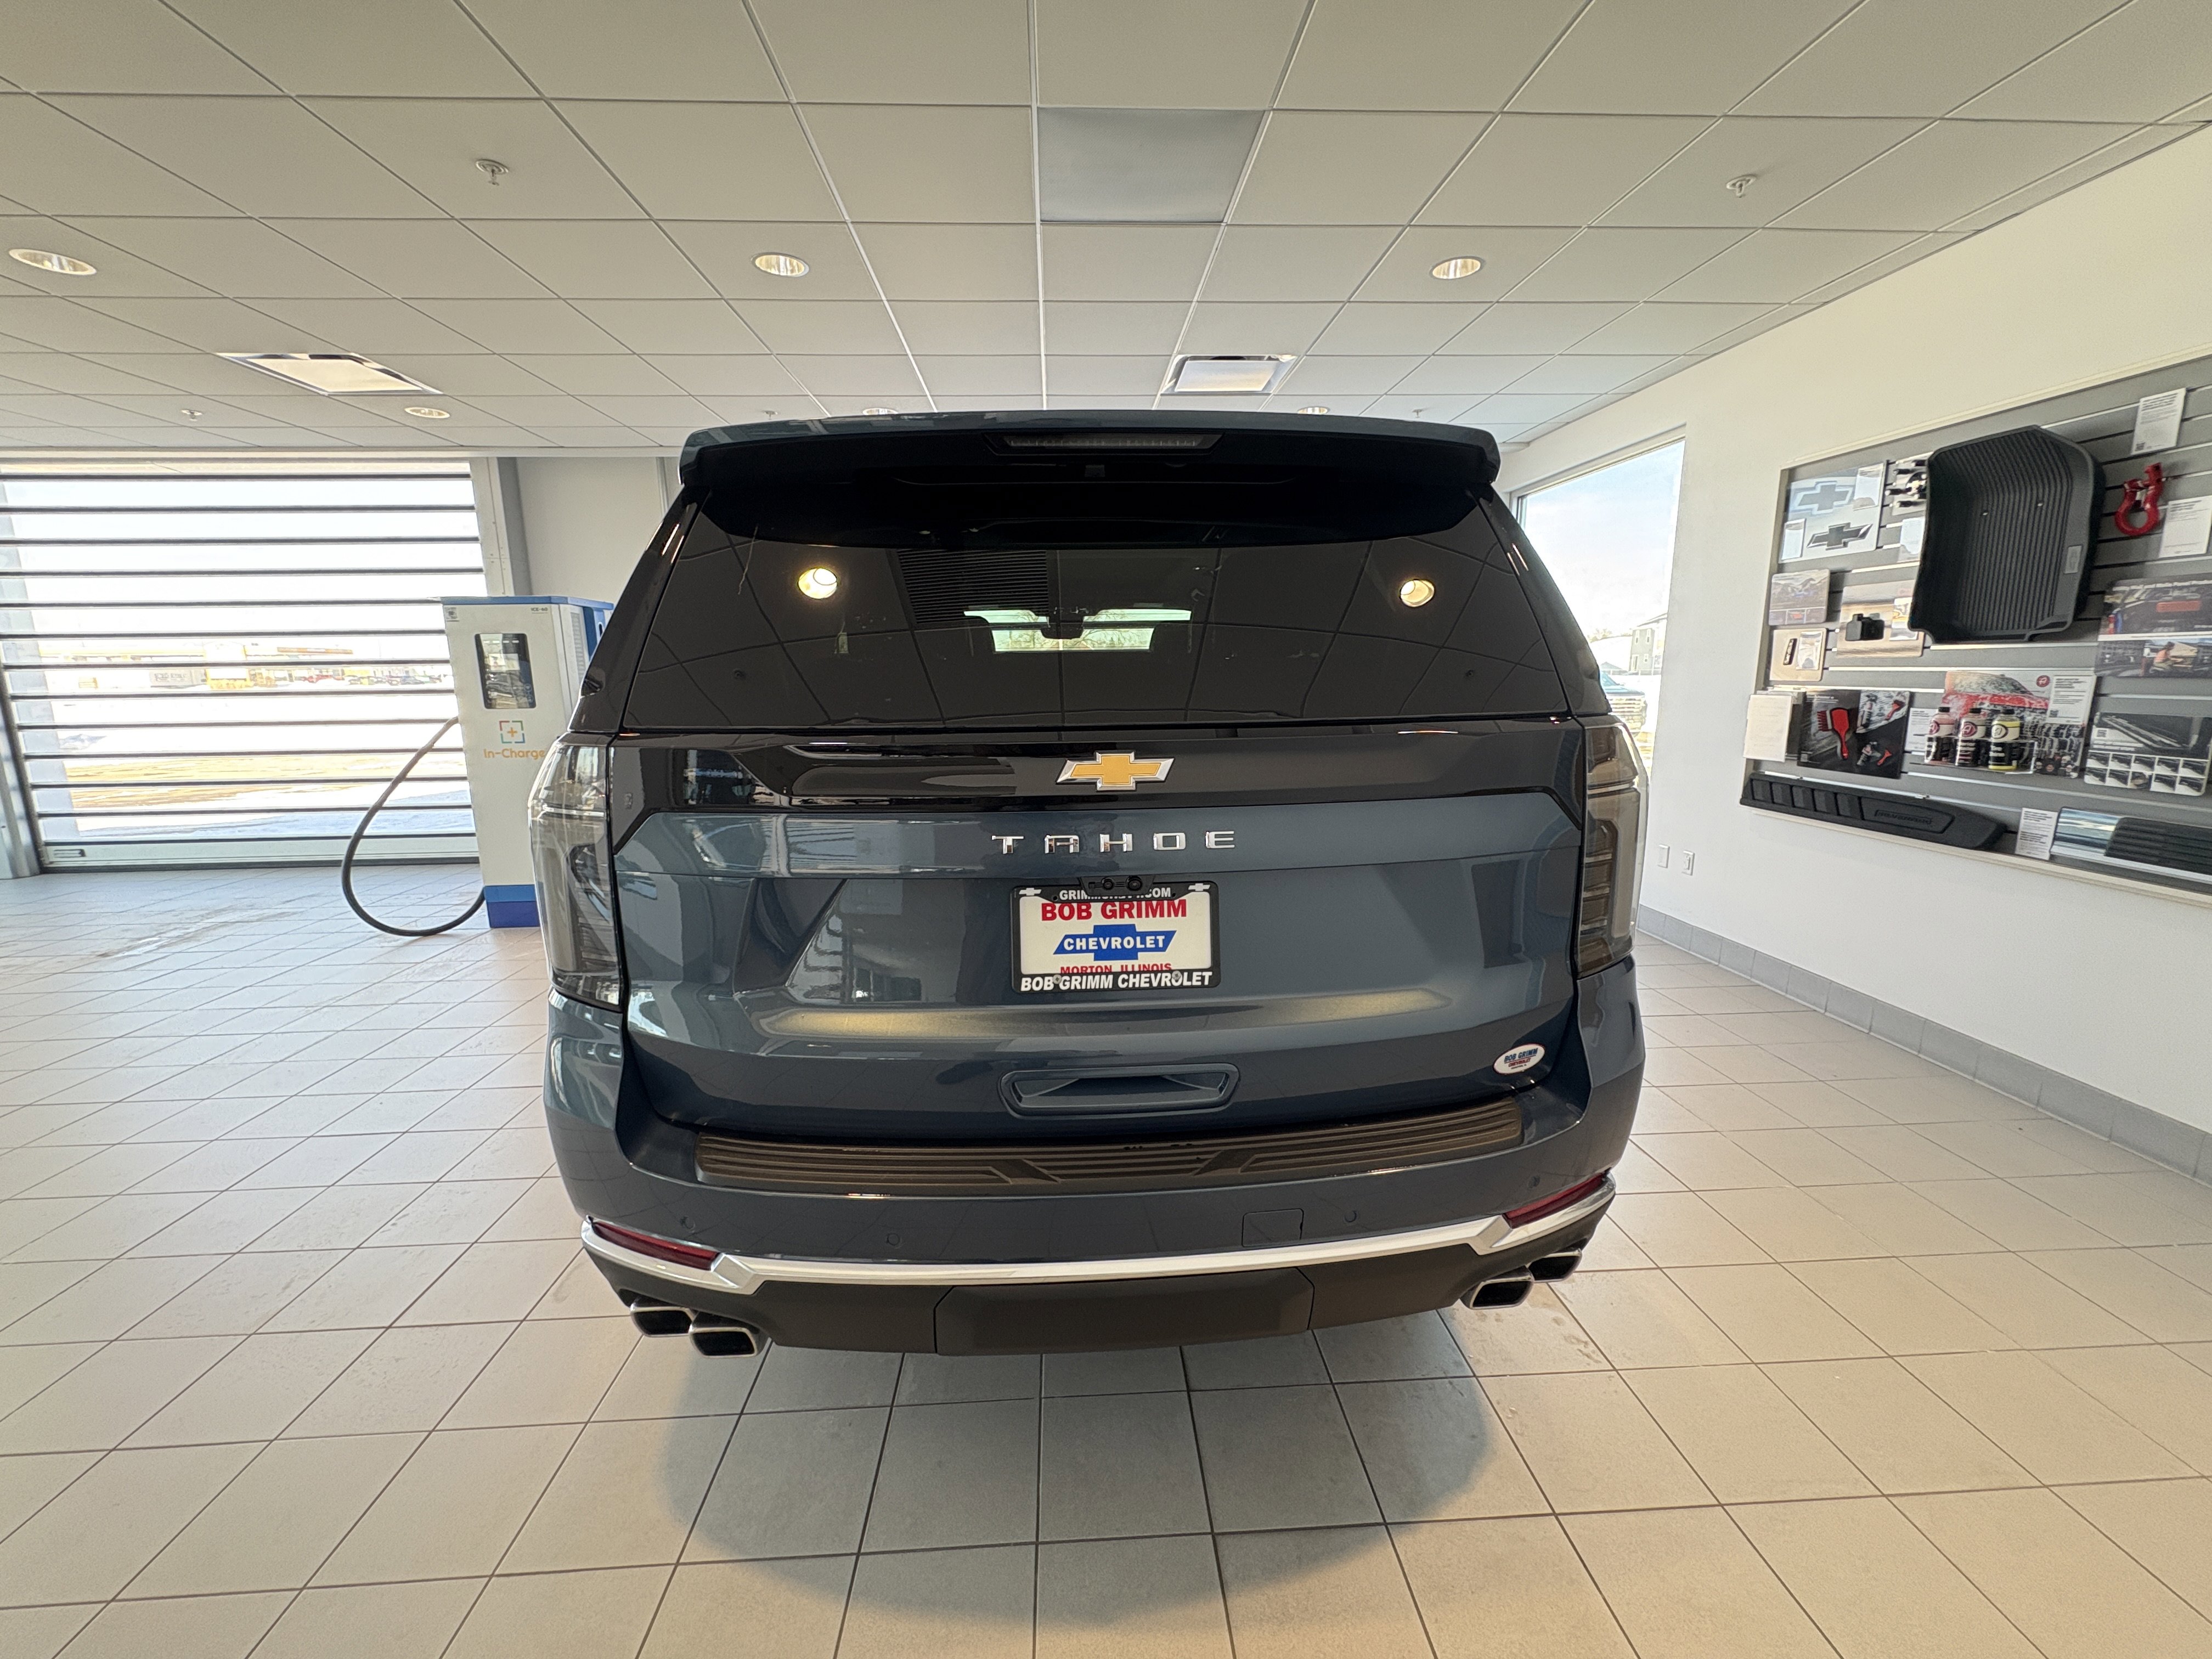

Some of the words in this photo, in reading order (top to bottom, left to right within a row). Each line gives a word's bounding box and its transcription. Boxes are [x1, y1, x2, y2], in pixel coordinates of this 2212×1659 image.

[483, 748, 545, 760] In-Charge
[991, 831, 1235, 854] TAHOE
[1041, 902, 1092, 921] BOB
[1101, 899, 1187, 919] GRIMM
[1063, 935, 1165, 951] CHEVROLET
[1020, 976, 1054, 991] BOB
[1059, 974, 1114, 990] GRIMM
[1118, 971, 1213, 988] CHEVROLET
[1504, 1053, 1516, 1062] BOB
[1518, 1048, 1538, 1058] GRIMM
